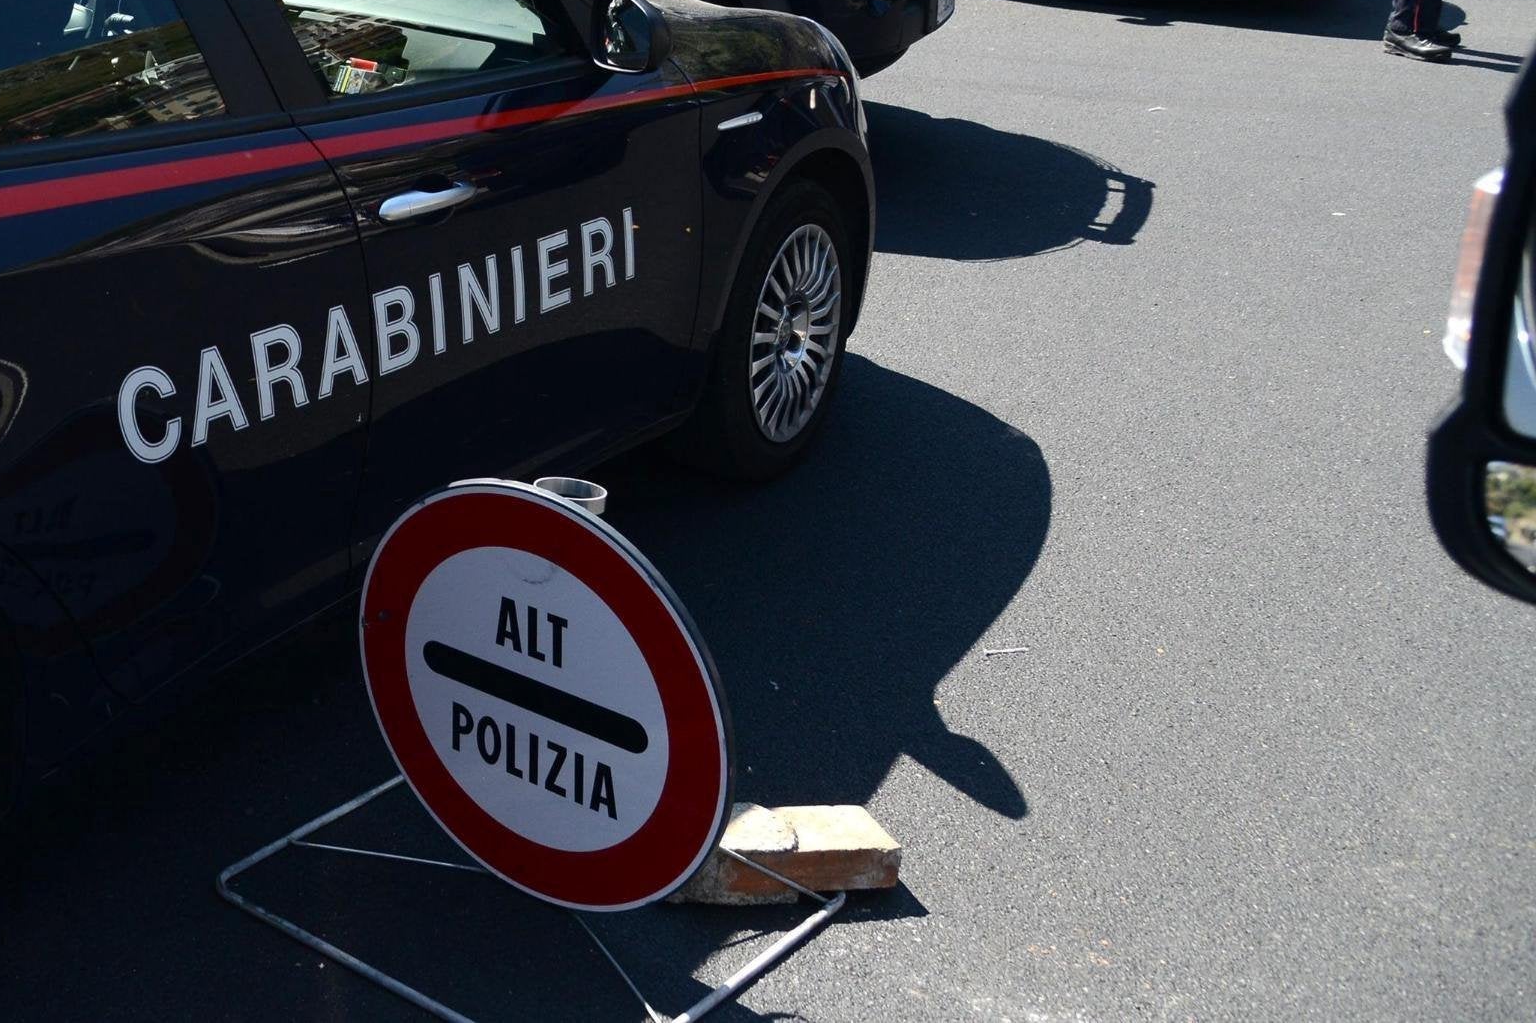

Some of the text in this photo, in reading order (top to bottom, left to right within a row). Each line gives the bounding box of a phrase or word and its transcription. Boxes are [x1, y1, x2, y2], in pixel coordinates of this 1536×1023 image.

[118, 207, 636, 464] CARABINIERI
[495, 595, 568, 669] ALT
[451, 701, 619, 821] POLIZIA
